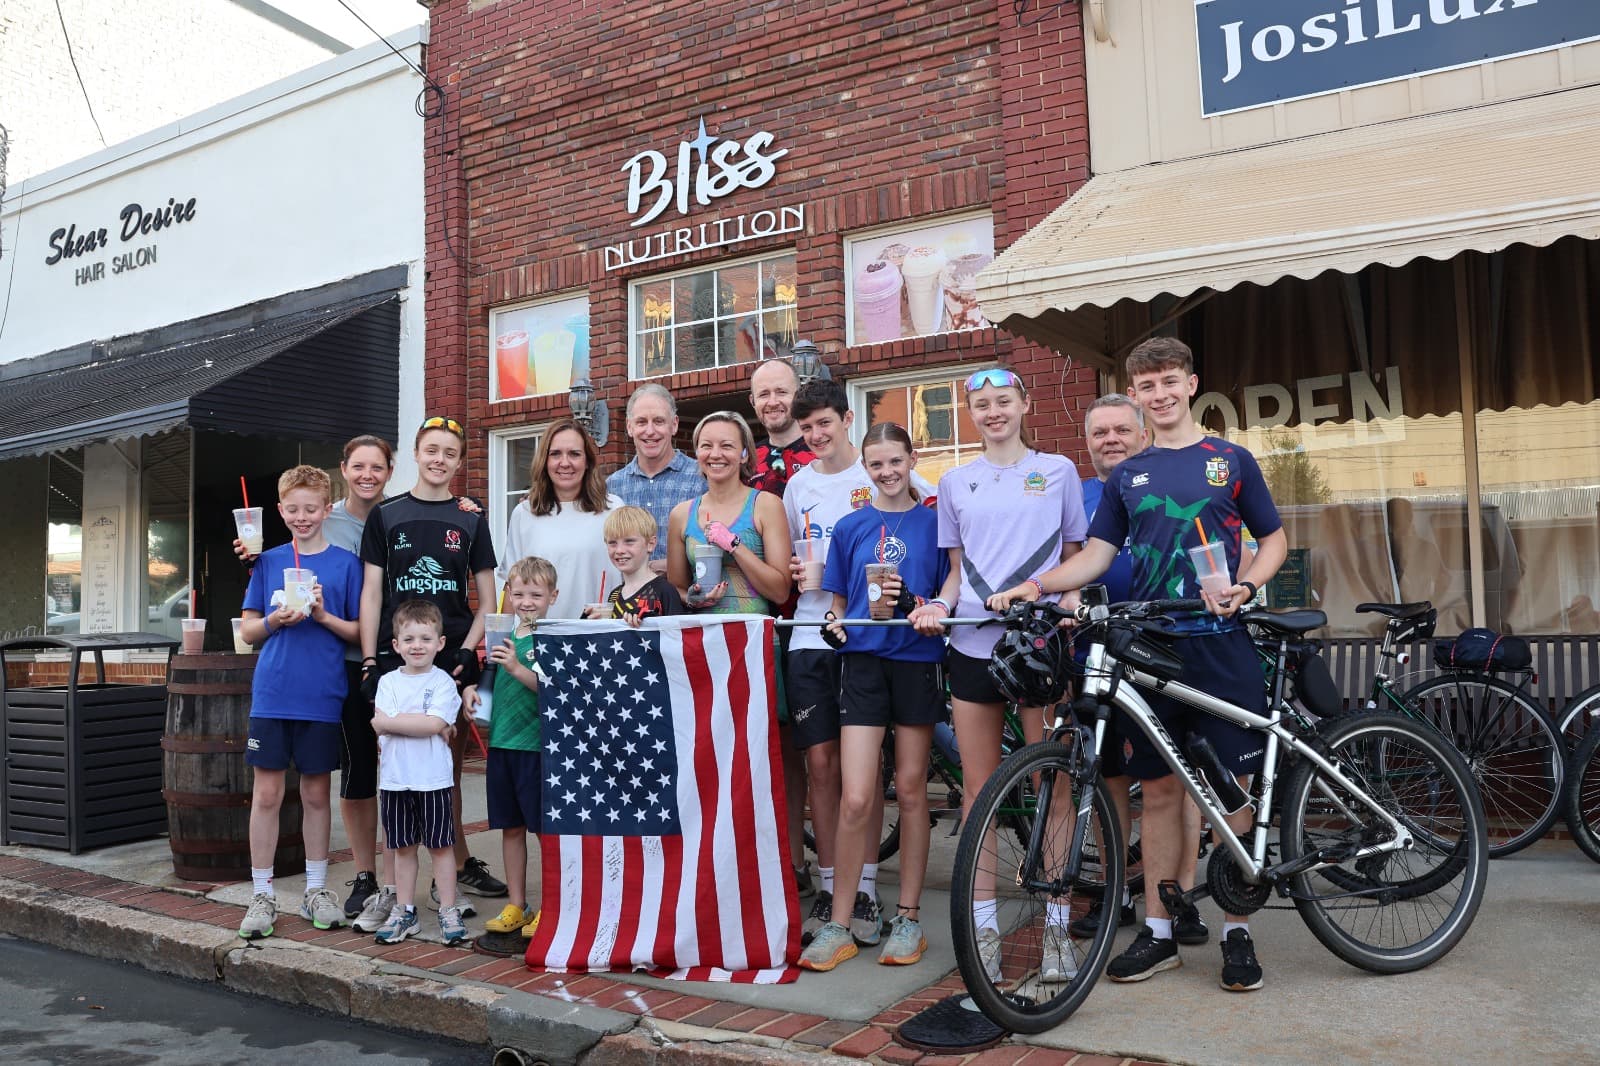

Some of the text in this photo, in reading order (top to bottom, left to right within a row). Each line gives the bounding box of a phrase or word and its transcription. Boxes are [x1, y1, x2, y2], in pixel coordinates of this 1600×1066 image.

[620, 115, 789, 227] Bliss
[45, 198, 197, 265] Shear Desire
[603, 204, 804, 271] NUTRITION
[75, 245, 157, 286] HAIR SALON
[1191, 366, 1406, 457] OPEN
[396, 576, 458, 595] Kingspan
